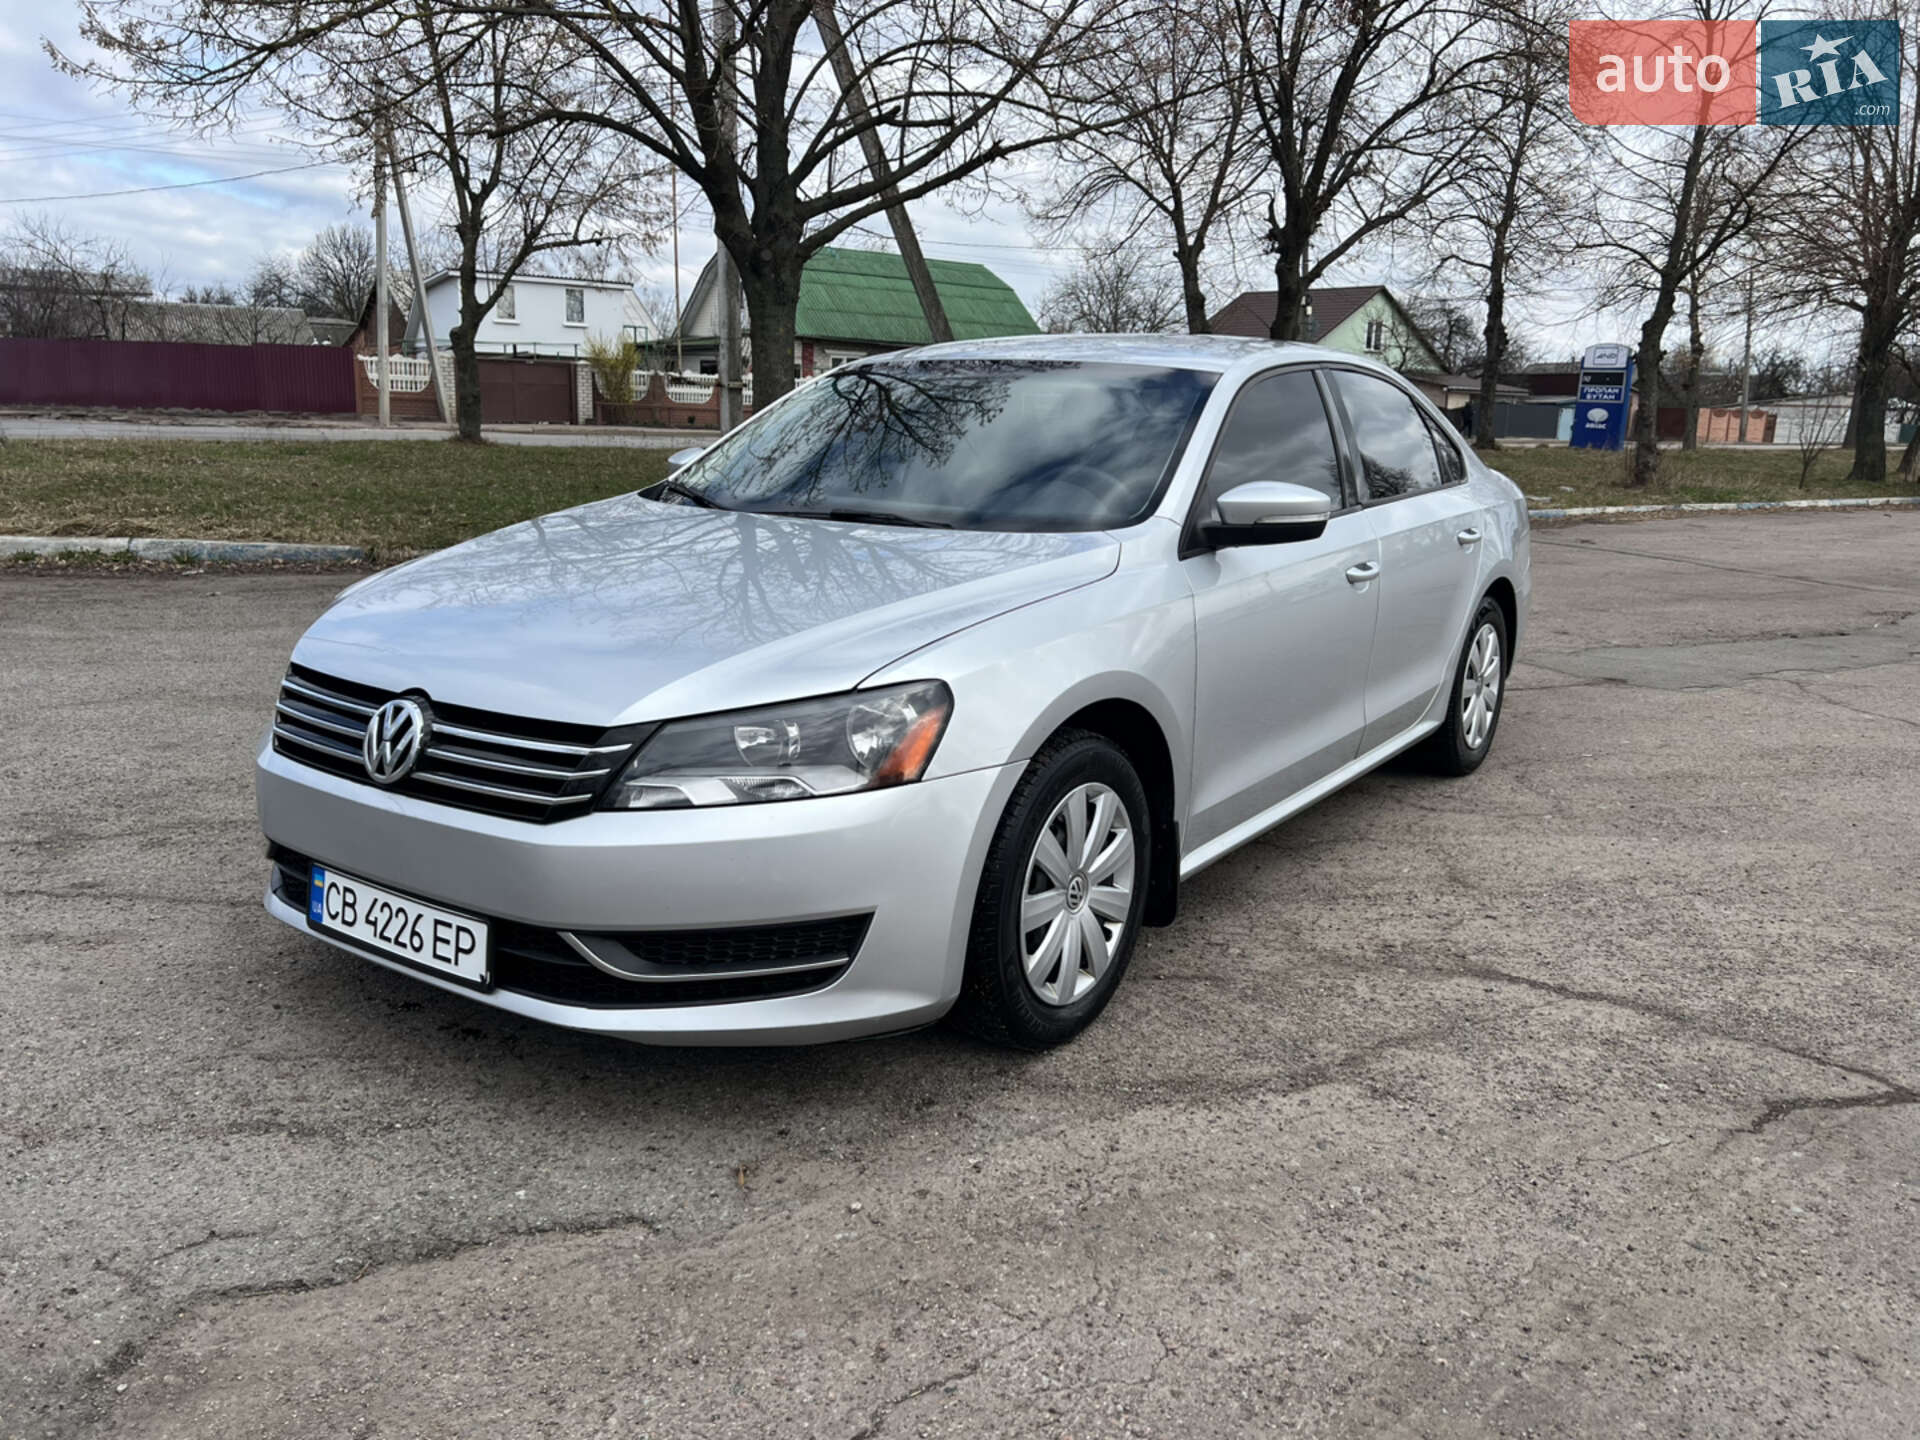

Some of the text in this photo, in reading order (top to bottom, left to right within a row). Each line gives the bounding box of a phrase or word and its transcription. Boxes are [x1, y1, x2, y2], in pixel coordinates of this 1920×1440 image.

[326, 881, 476, 966] CB 4226 EP
